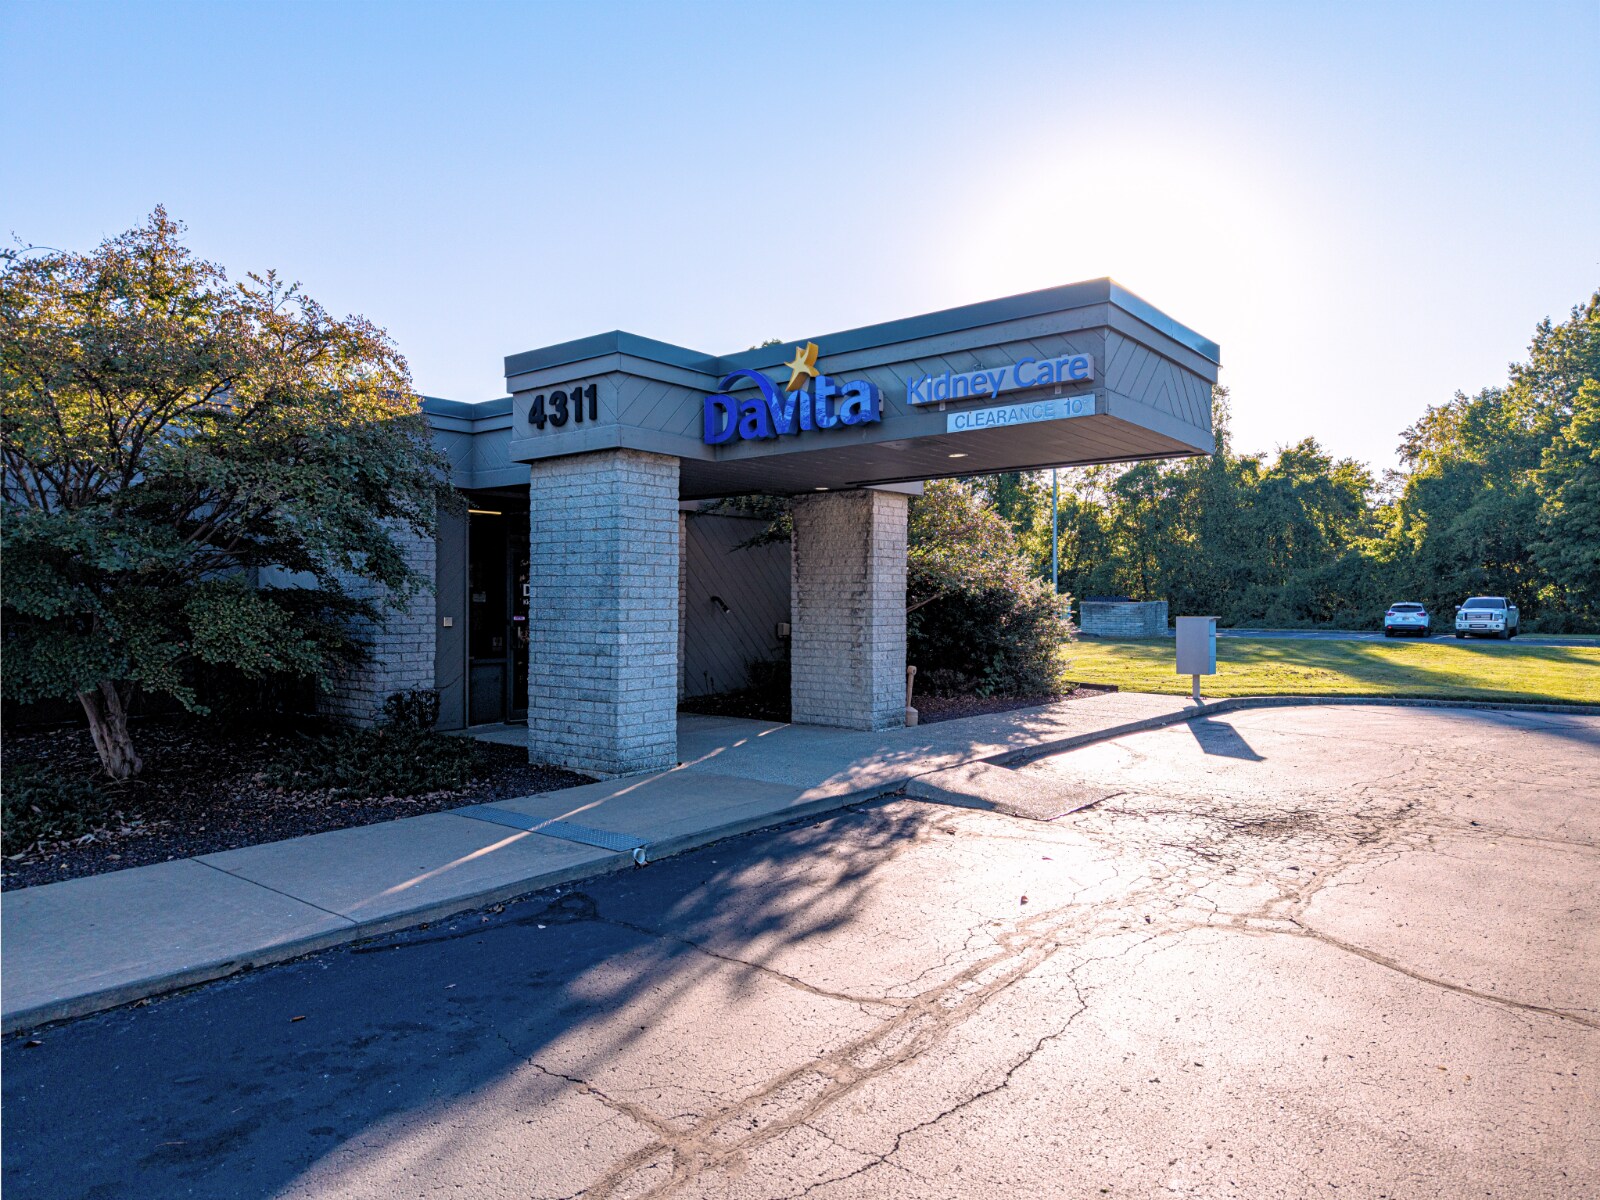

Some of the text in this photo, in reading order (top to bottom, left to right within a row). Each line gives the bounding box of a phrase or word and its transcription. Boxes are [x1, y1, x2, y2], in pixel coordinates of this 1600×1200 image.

[907, 356, 1089, 405] Kidney Care
[528, 383, 598, 430] 4311
[704, 368, 881, 445] DaVita
[954, 404, 1056, 430] CLEARANCE
